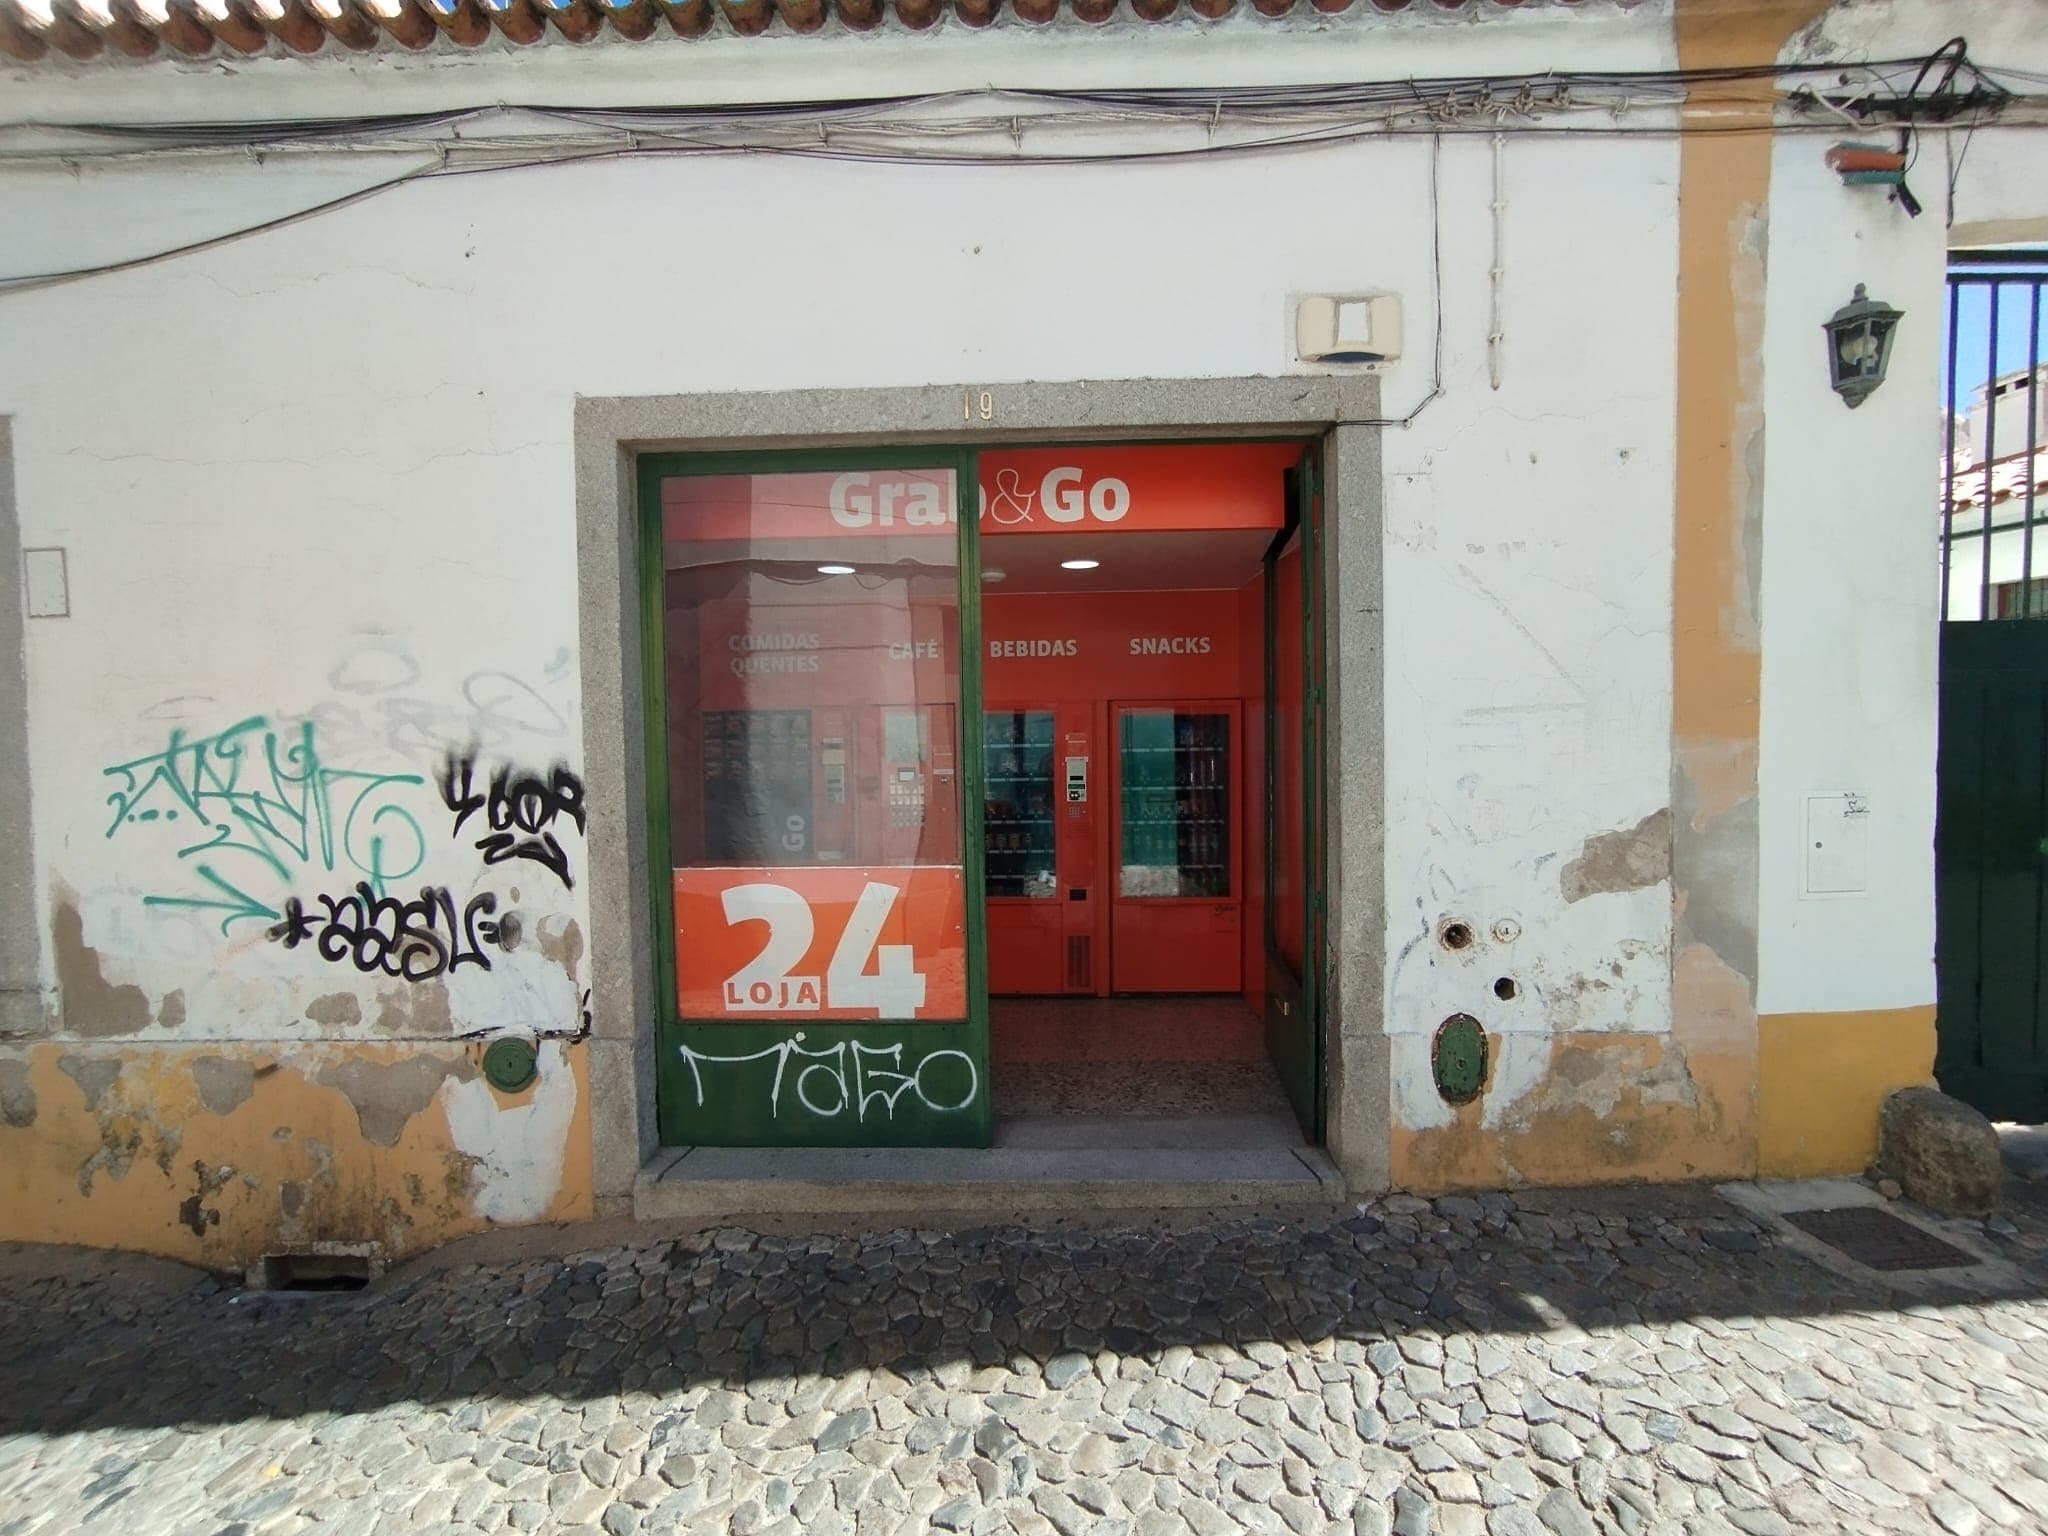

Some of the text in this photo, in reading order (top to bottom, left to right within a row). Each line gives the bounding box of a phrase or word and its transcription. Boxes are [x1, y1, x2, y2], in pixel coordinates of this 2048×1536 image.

[964, 390, 993, 420] 19
[728, 632, 820, 653] COMIDAS
[888, 638, 939, 660] CAFÉ
[989, 639, 1078, 658] BEBIDAS
[1129, 636, 1211, 656] SNACKS
[730, 655, 820, 678] QUENTES
[720, 881, 927, 1020] 24
[726, 981, 819, 1008] LOJA
